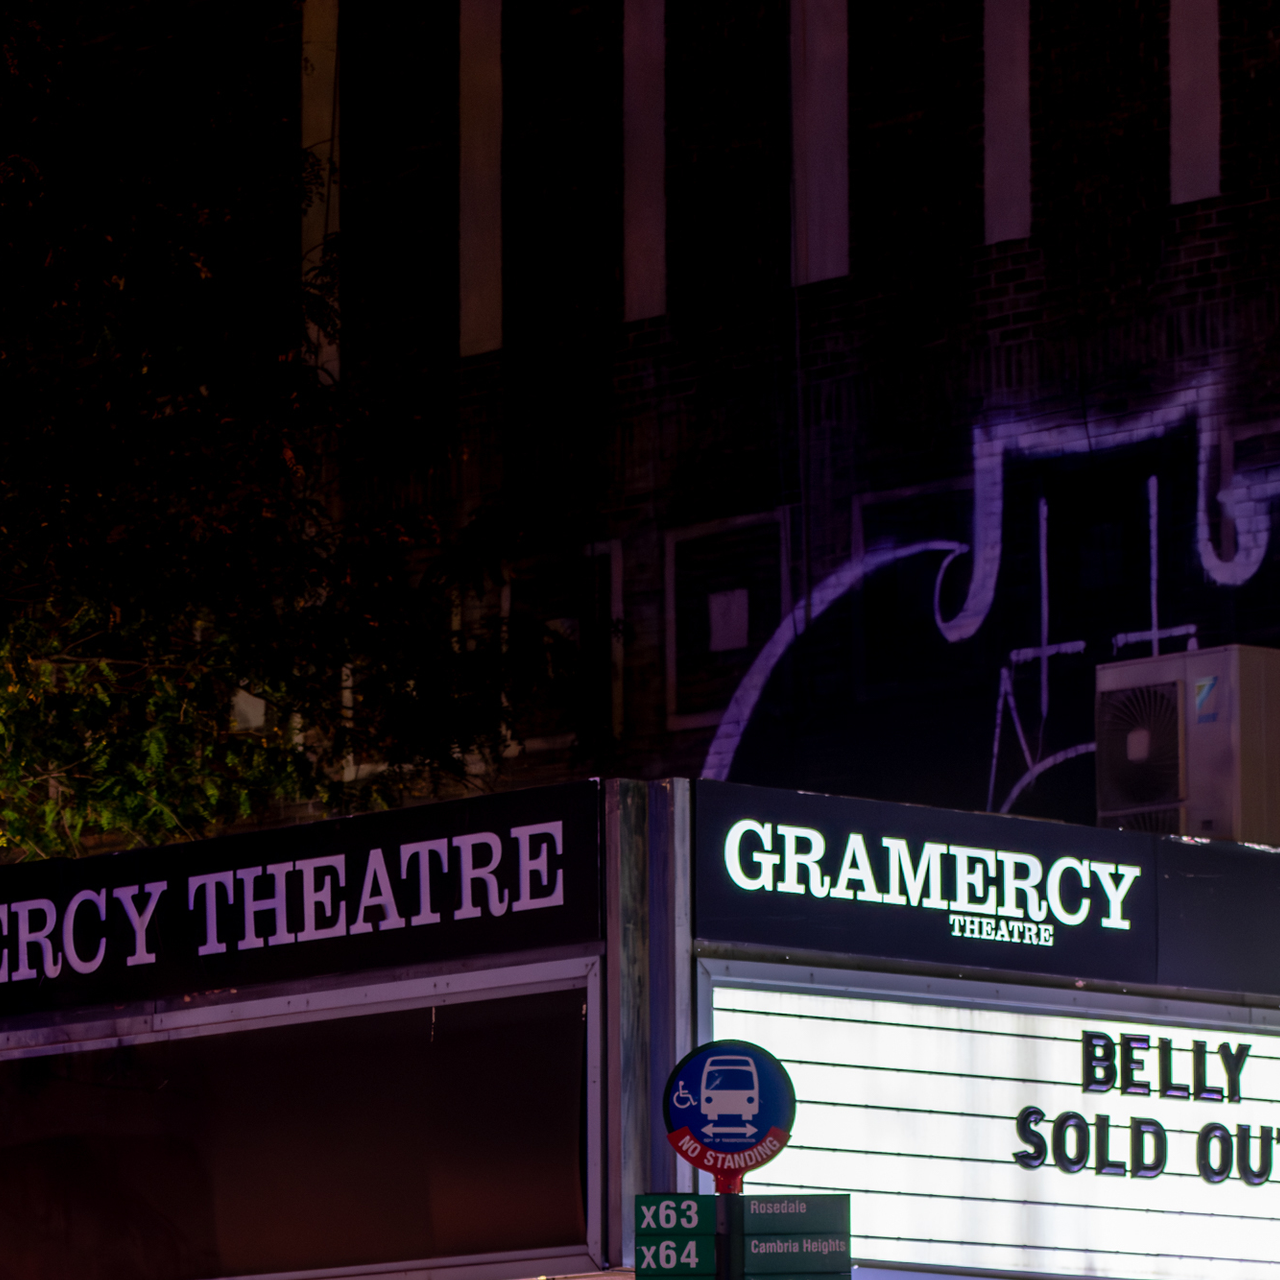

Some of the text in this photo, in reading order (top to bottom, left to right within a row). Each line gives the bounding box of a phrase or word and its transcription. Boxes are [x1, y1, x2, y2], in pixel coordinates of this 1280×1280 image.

[188, 819, 565, 956] THEATRE
[723, 817, 1142, 932] GRAMERCY
[949, 912, 1054, 948] THEATRE
[1081, 1030, 1251, 1104] BELLY
[678, 1134, 780, 1170] NO STANDING
[1013, 1105, 1167, 1180] SOLD
[750, 1199, 807, 1214] Rosedale
[750, 1238, 846, 1256] Cambria Heights
